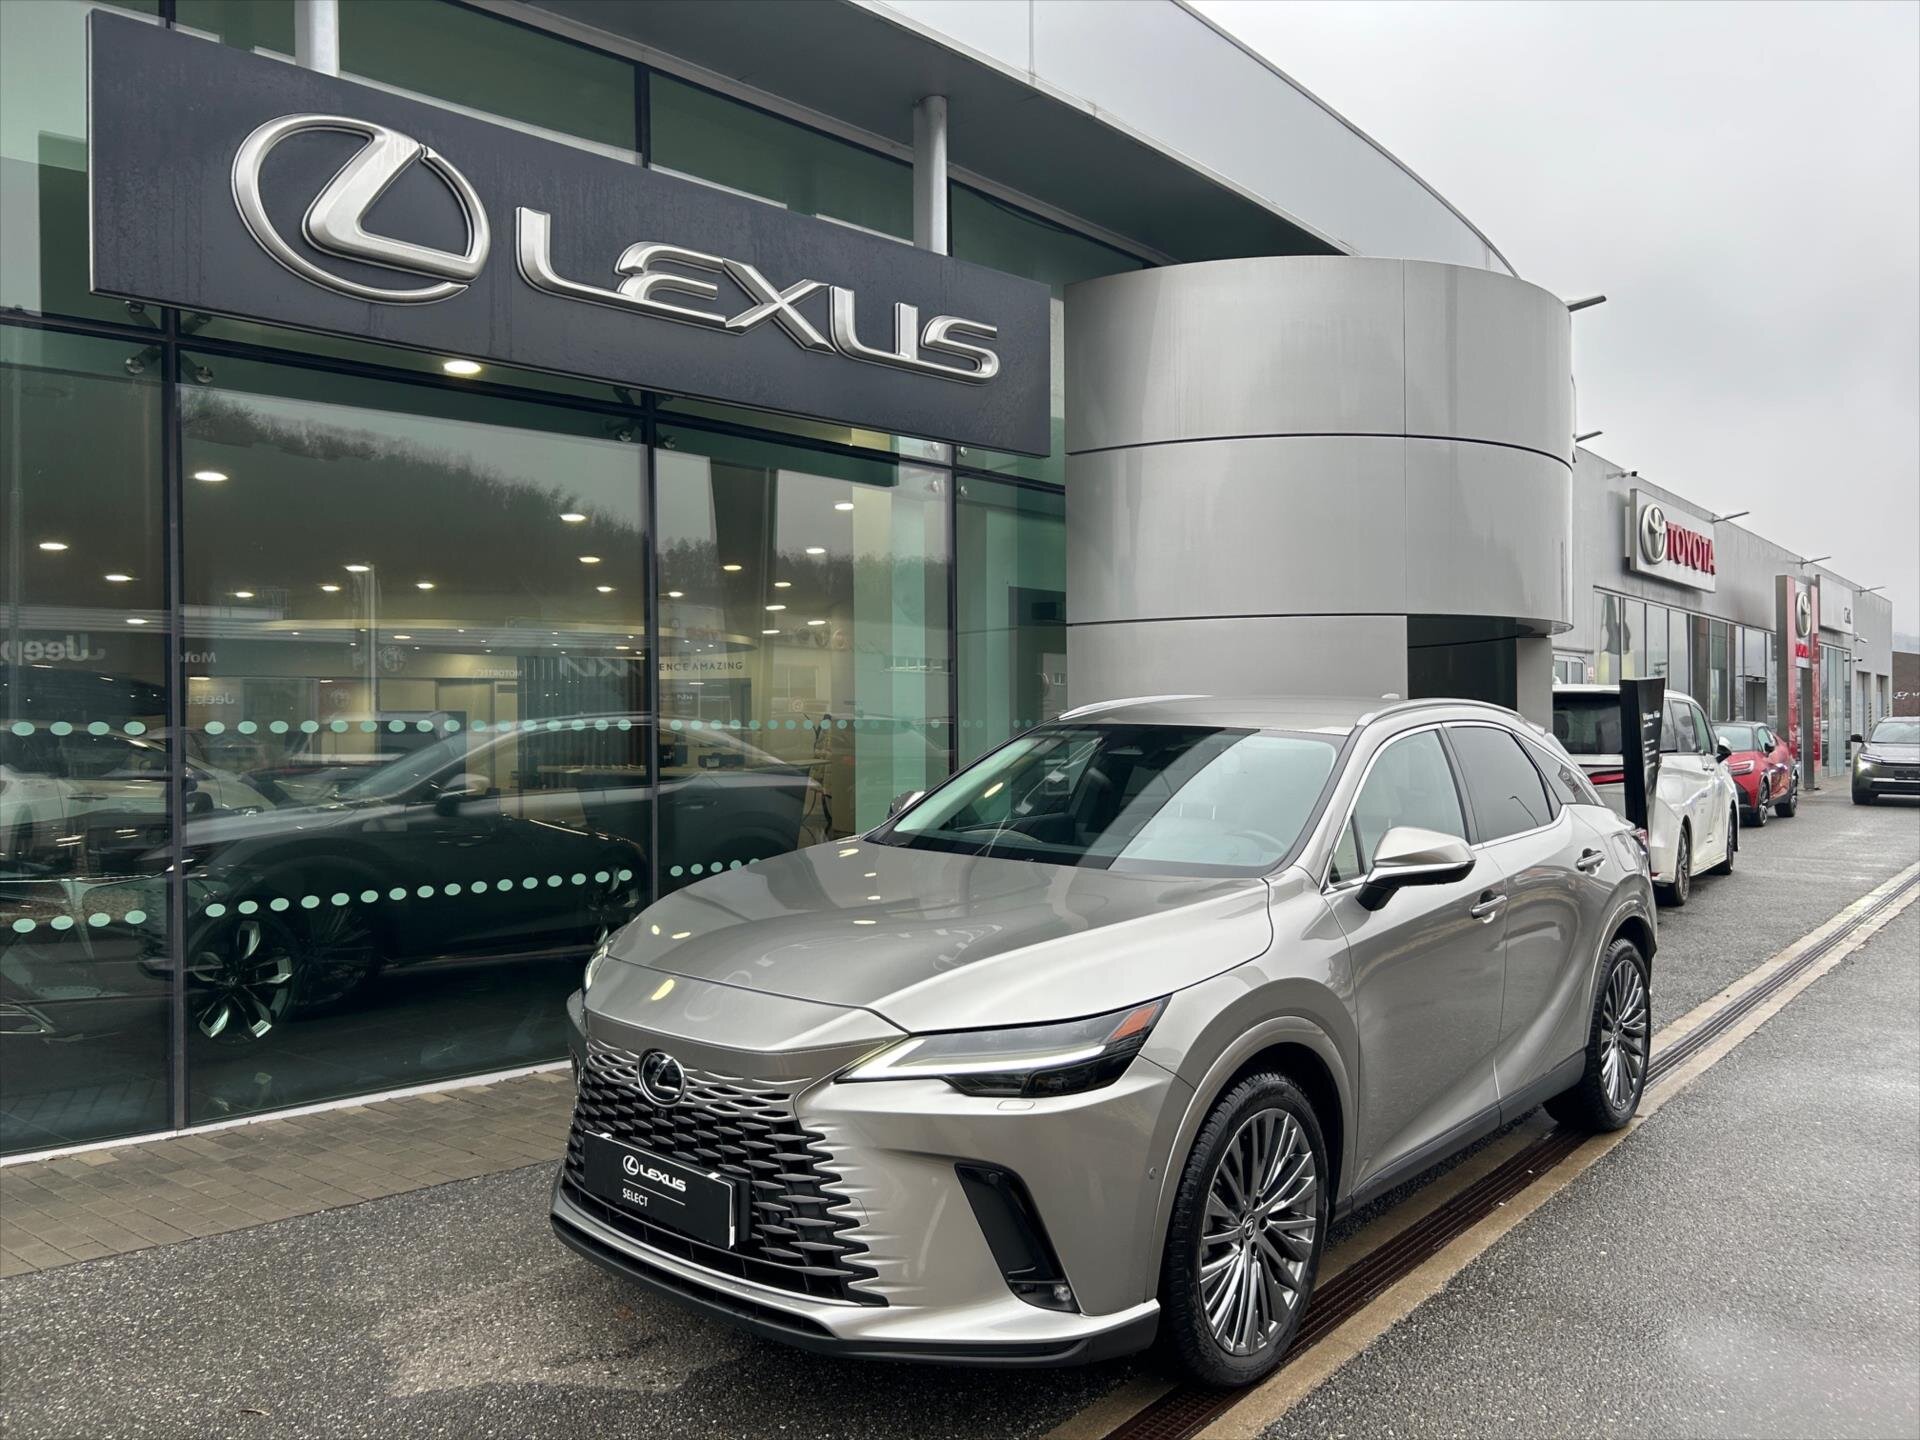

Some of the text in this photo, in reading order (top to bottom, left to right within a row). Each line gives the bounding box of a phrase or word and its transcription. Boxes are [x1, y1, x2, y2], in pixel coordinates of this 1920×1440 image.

[516, 206, 1001, 384] LEXUS
[1665, 521, 1715, 575] TOYOTA
[692, 661, 743, 671] AMAZING
[640, 1164, 686, 1192] LEXUS
[622, 1188, 648, 1207] SELECT
